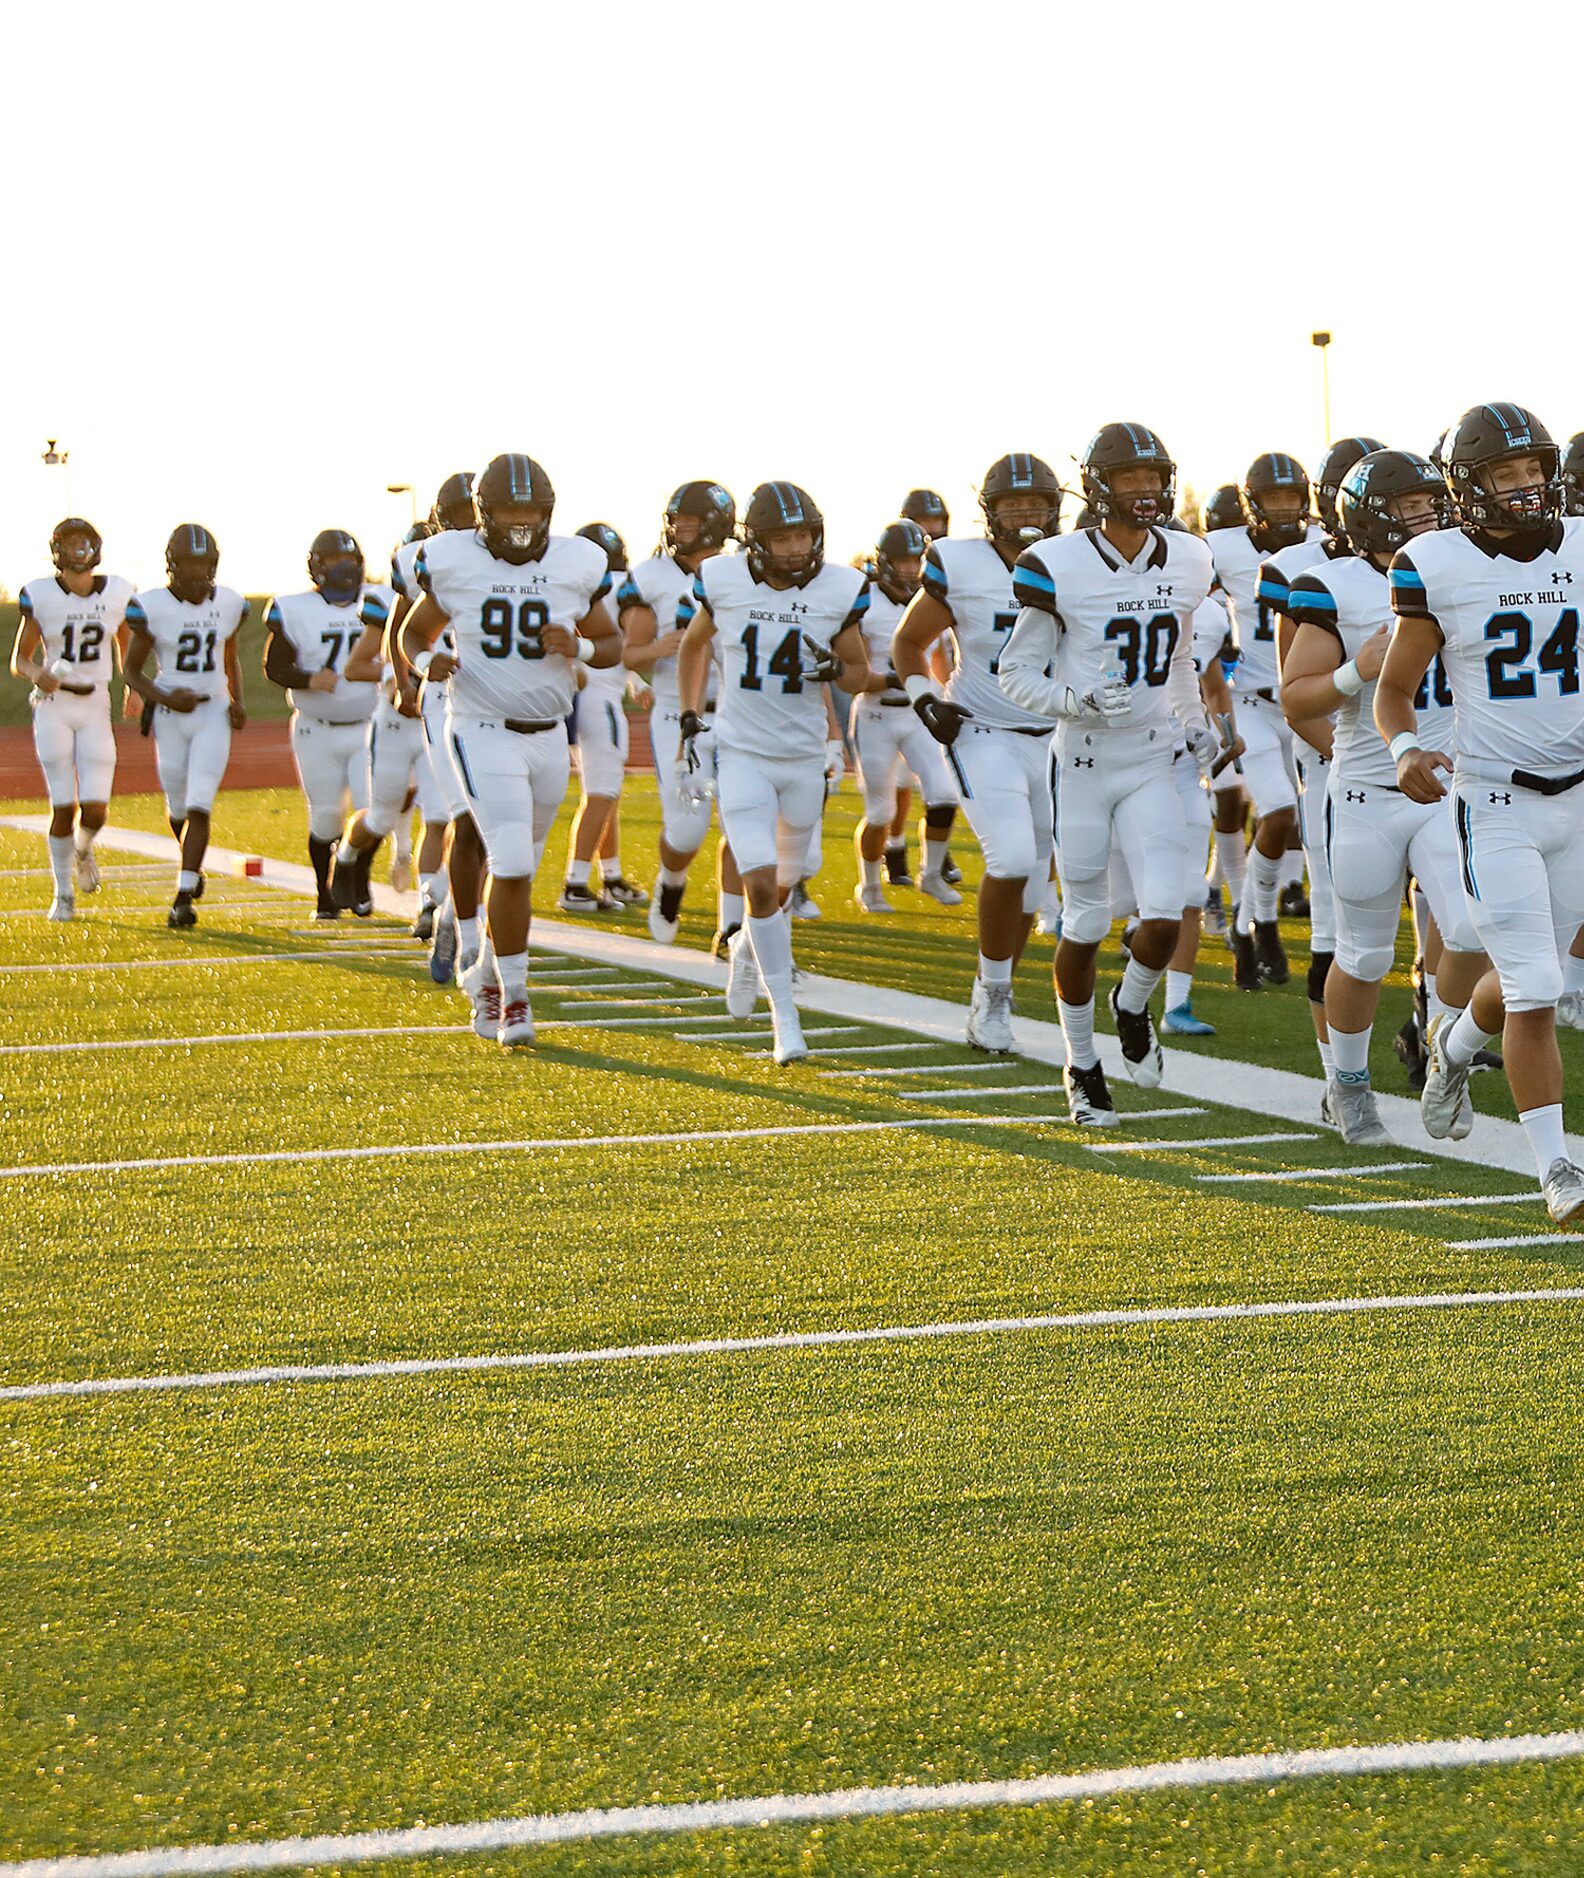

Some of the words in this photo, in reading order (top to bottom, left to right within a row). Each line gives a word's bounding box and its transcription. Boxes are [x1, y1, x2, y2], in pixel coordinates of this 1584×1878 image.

[492, 584, 517, 594] ROCK
[519, 585, 541, 595] HILL
[1117, 600, 1145, 613] ROCK
[1147, 599, 1171, 610] HILL
[1498, 593, 1534, 607] ROCK
[1537, 591, 1568, 604] HILL
[480, 596, 550, 660] 99
[749, 609, 775, 622] ROCK
[778, 612, 801, 624] HILL
[60, 621, 106, 663] 12
[175, 629, 218, 673] 21
[740, 623, 804, 694] 14
[1104, 611, 1180, 687] 30
[1483, 607, 1580, 700] 24
